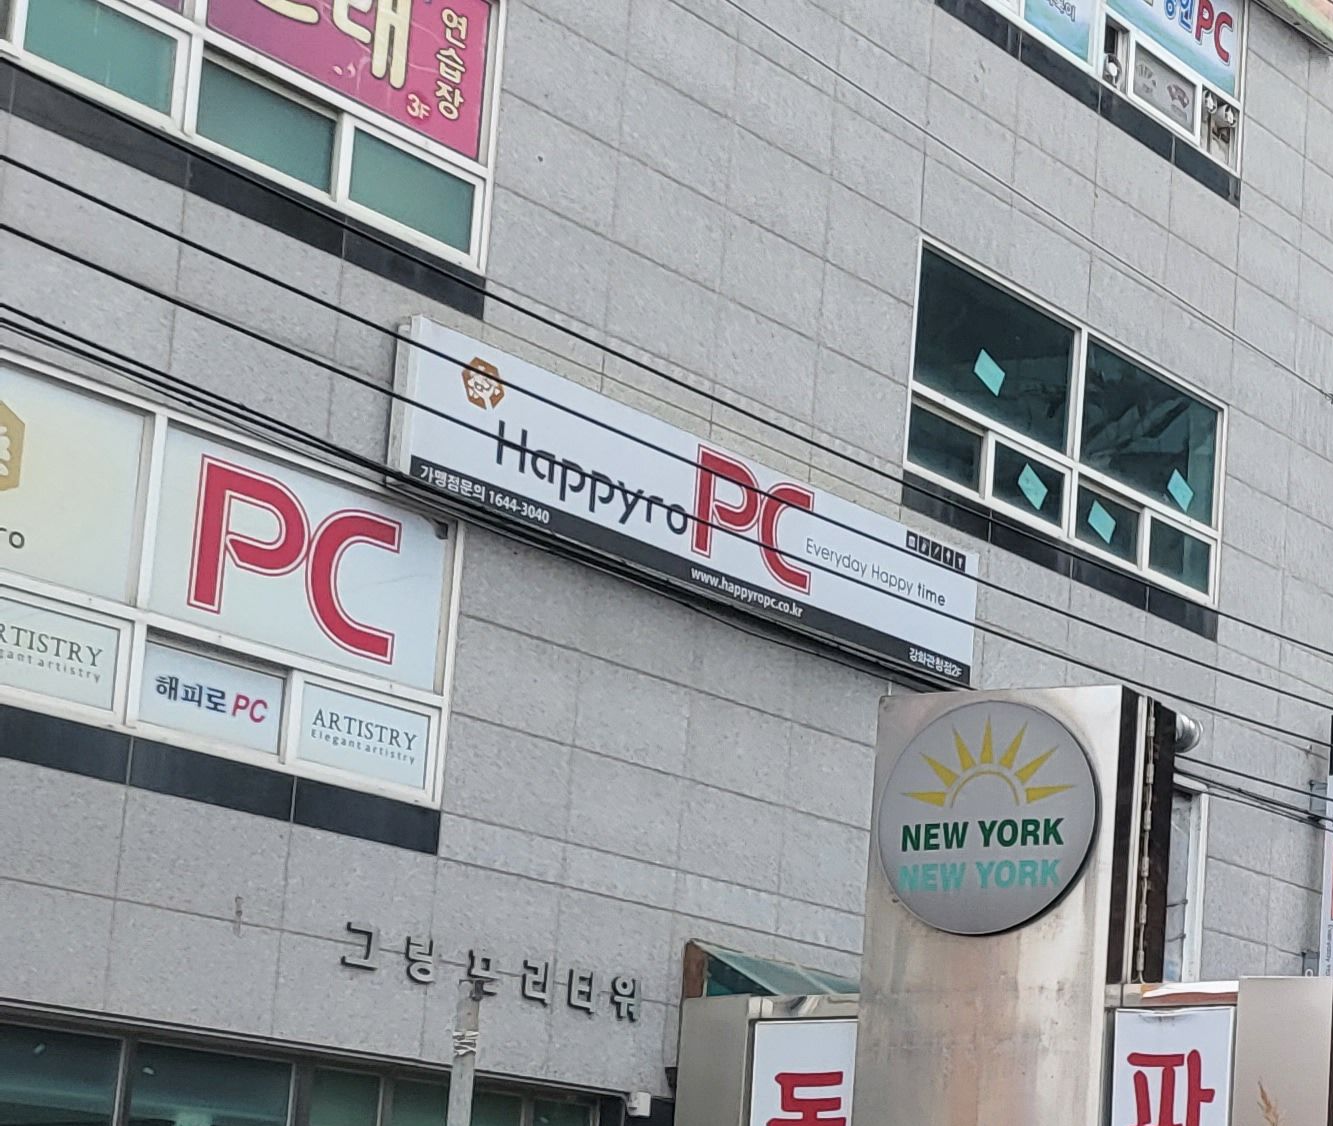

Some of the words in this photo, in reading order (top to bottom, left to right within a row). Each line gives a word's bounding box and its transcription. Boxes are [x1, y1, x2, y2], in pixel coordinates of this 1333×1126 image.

[250, 0, 411, 89] 래
[436, 8, 468, 120] 연습장
[406, 94, 431, 119] 3F
[420, 464, 486, 503] 가맹점문의
[488, 490, 551, 525] 1644-3040
[495, 419, 690, 535] Happyro
[691, 443, 815, 596] PC
[187, 453, 402, 665] PC
[806, 537, 868, 577] Everyday
[871, 563, 914, 594] Happy
[917, 584, 946, 606] time
[691, 566, 803, 618] www.happyropc.co.kr
[155, 675, 227, 714] 해피로
[231, 692, 269, 723] PC
[311, 729, 363, 750] Elegant
[365, 742, 415, 766] artistry
[312, 708, 418, 751] ARTISTRY
[901, 821, 969, 852] NEW
[978, 817, 1065, 848] YORK
[897, 864, 967, 893] NEW
[975, 858, 1062, 889] YORK
